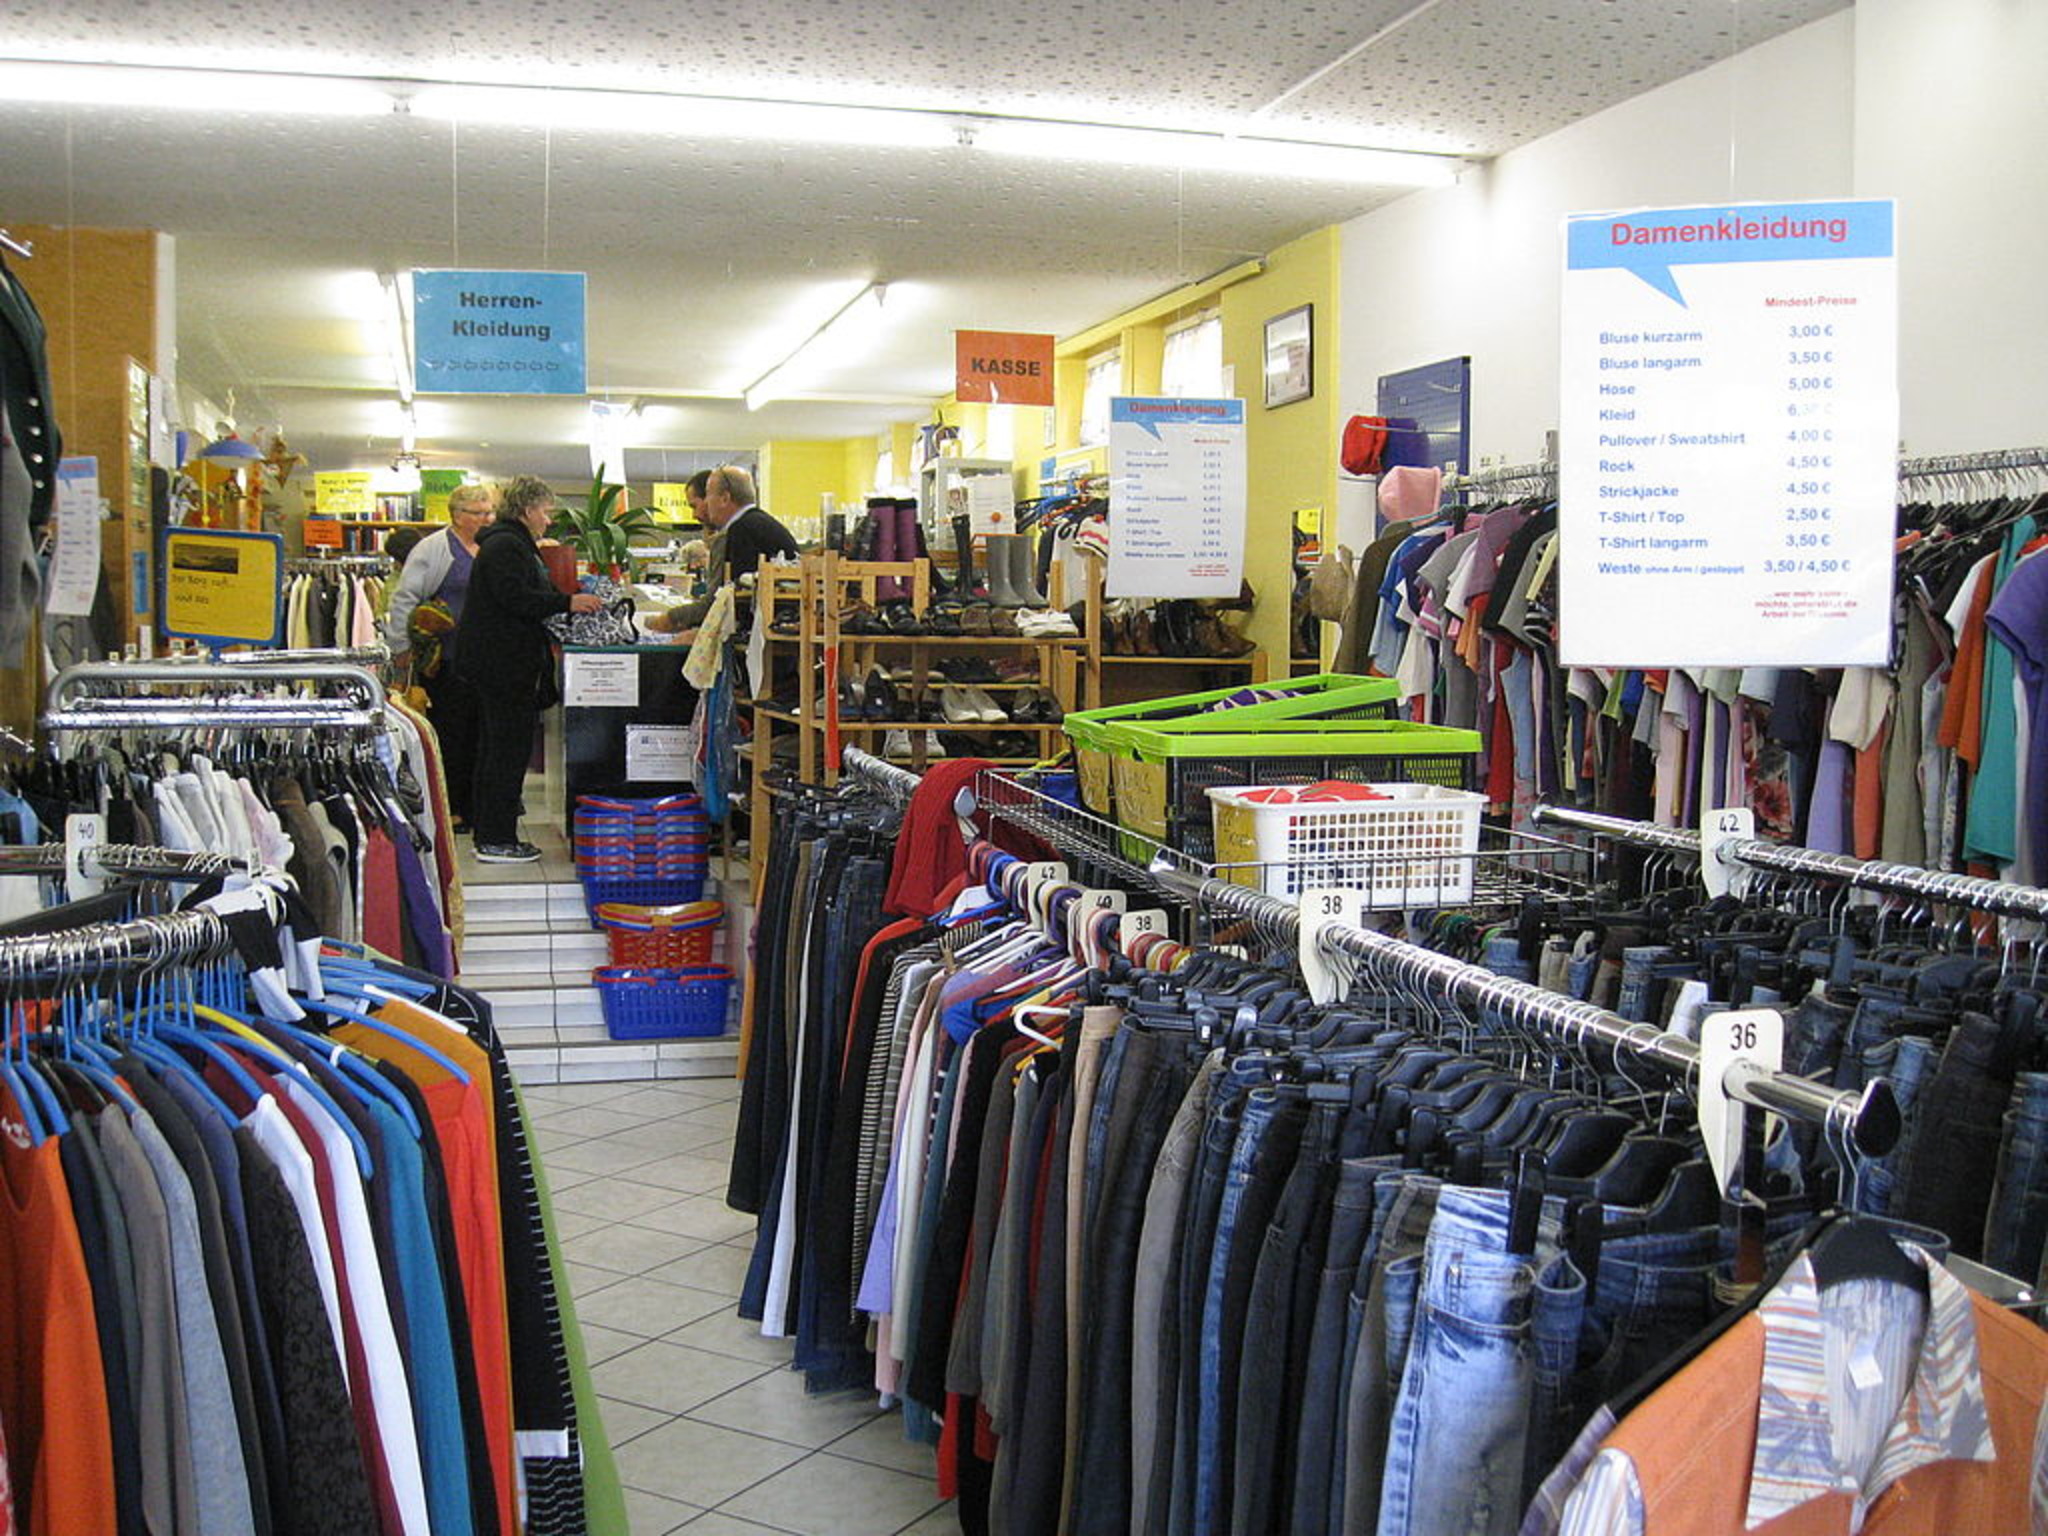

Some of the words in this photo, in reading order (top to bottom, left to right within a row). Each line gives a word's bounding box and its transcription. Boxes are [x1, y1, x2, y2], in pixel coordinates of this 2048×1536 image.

[1611, 216, 1848, 245] Damenkleidung
[460, 292, 543, 308] Herren-
[1765, 296, 1857, 307] Mindest-Preise
[452, 320, 551, 342] Kleidung
[1600, 332, 1639, 344] Bluse
[1643, 332, 1702, 343] kurzarm
[1789, 325, 1821, 338] 3,00
[971, 357, 1041, 376] KASSE
[1600, 358, 1639, 370] Bluse
[1643, 357, 1702, 371] langarm
[1789, 352, 1820, 364] 3,50
[1600, 384, 1635, 395] Hose
[1789, 378, 1821, 391] 5,00
[1599, 409, 1635, 420] Kleid
[1599, 434, 1656, 446] Pullover
[1668, 433, 1745, 445] Sweatshirt
[1599, 460, 1634, 472] Rock
[1787, 456, 1819, 469] 4,50
[1599, 486, 1679, 500] Strickjacke
[1786, 482, 1818, 495] 4,50
[1599, 512, 1646, 523] T-Shirt
[1658, 511, 1685, 524] Top
[1787, 508, 1818, 522] 2,50
[1599, 537, 1646, 548] T-Shirt
[1649, 537, 1708, 551] langarm
[1786, 534, 1818, 548] 3,50
[1598, 563, 1642, 574] Weste
[1764, 560, 1796, 574] 3,50
[1806, 560, 1838, 573] 4,50
[78, 822, 95, 840] 40
[1719, 814, 1739, 832] 42
[1322, 895, 1343, 915] 38
[1136, 916, 1152, 930] 38
[1731, 1023, 1756, 1051] 36
